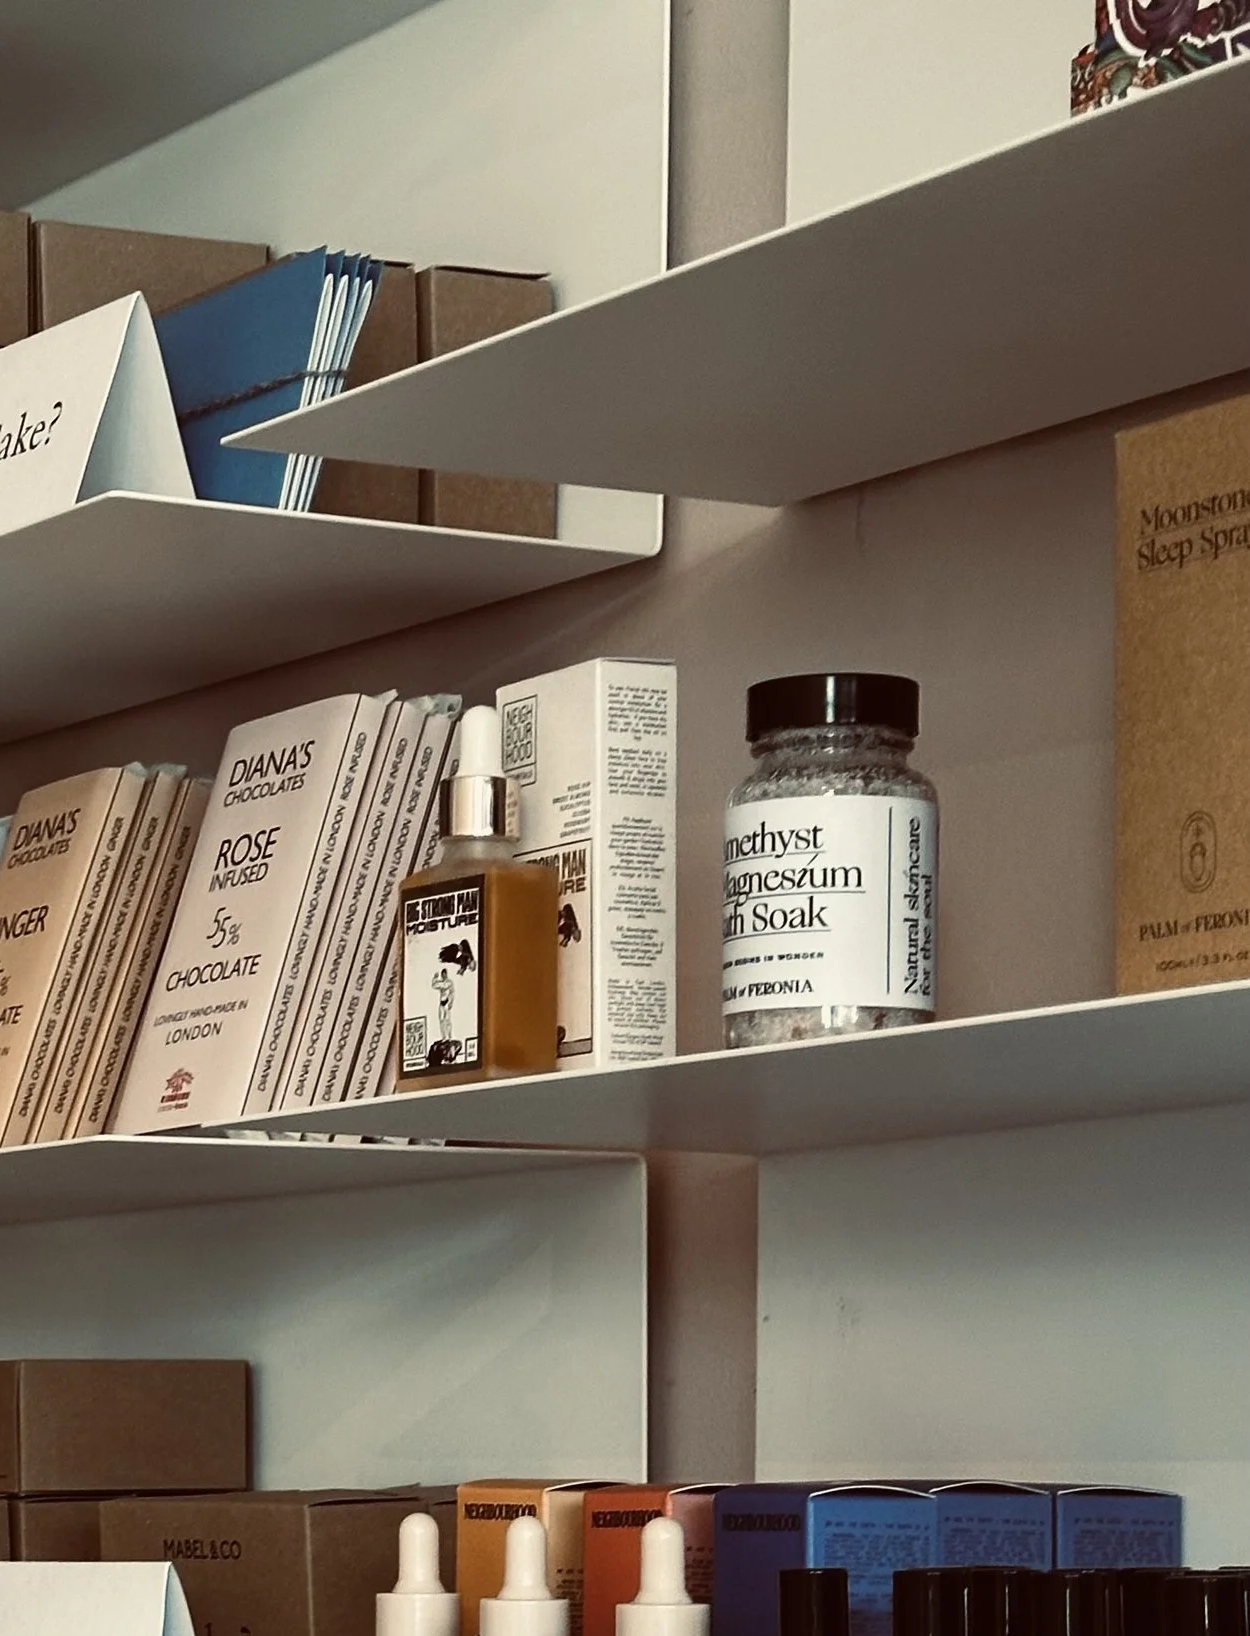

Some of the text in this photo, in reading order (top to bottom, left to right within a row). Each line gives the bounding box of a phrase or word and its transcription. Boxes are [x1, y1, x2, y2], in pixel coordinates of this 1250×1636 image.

[1136, 538, 1193, 571] Sleep
[229, 740, 315, 788] DIANA'S
[223, 773, 306, 807] CHOCOLATES
[13, 808, 81, 852] DIANA'S
[328, 804, 348, 852] LONDON
[724, 821, 826, 859] methyst
[7, 838, 72, 870] CHOCOLATES
[214, 826, 281, 871] ROSE
[208, 862, 269, 892] INFUSED
[725, 854, 864, 906] agnesium
[752, 896, 830, 932] Soak
[903, 815, 921, 996] Natural skincare
[206, 906, 243, 949] 55%
[406, 913, 479, 936] MOISTURE
[1139, 908, 1250, 941] PALM FERONI
[919, 928, 932, 962] the
[165, 954, 262, 992] CHOCOLATE
[748, 979, 814, 998] FERONIA
[165, 1022, 223, 1046] LONDON
[163, 1538, 242, 1561] MABEL&CO
